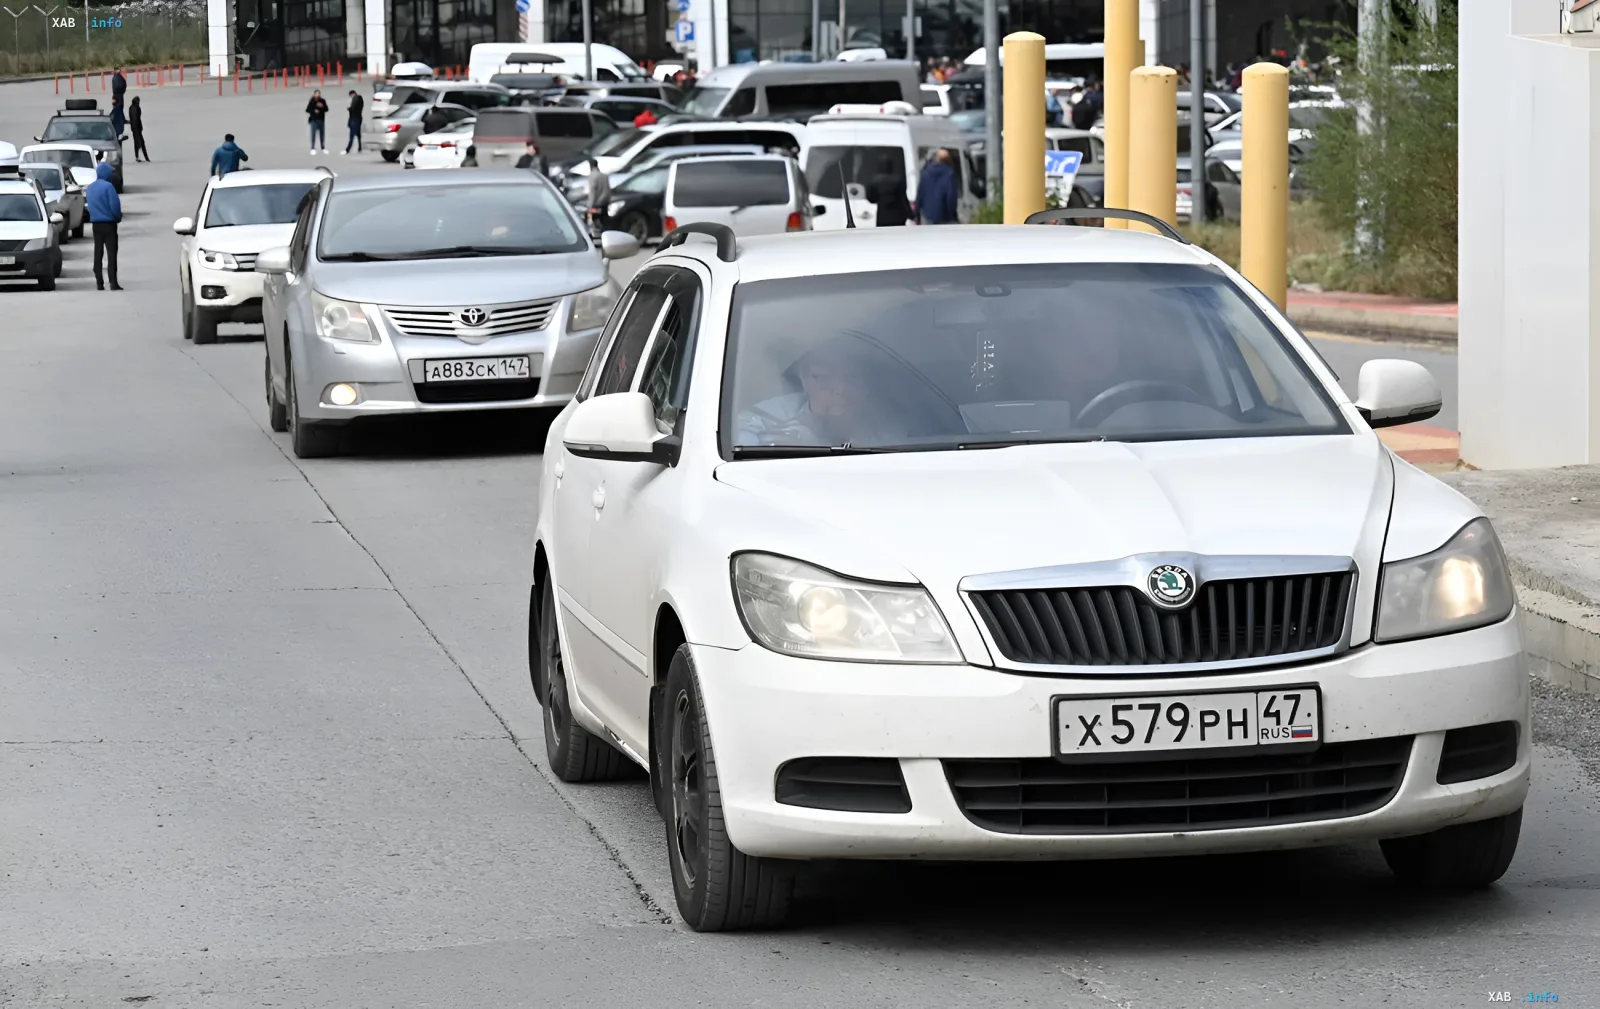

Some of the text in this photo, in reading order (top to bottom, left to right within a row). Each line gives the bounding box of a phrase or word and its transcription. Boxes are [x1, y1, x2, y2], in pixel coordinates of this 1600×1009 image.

[1077, 693, 1302, 747] Х579РН 47
[1260, 726, 1290, 740] RUS
